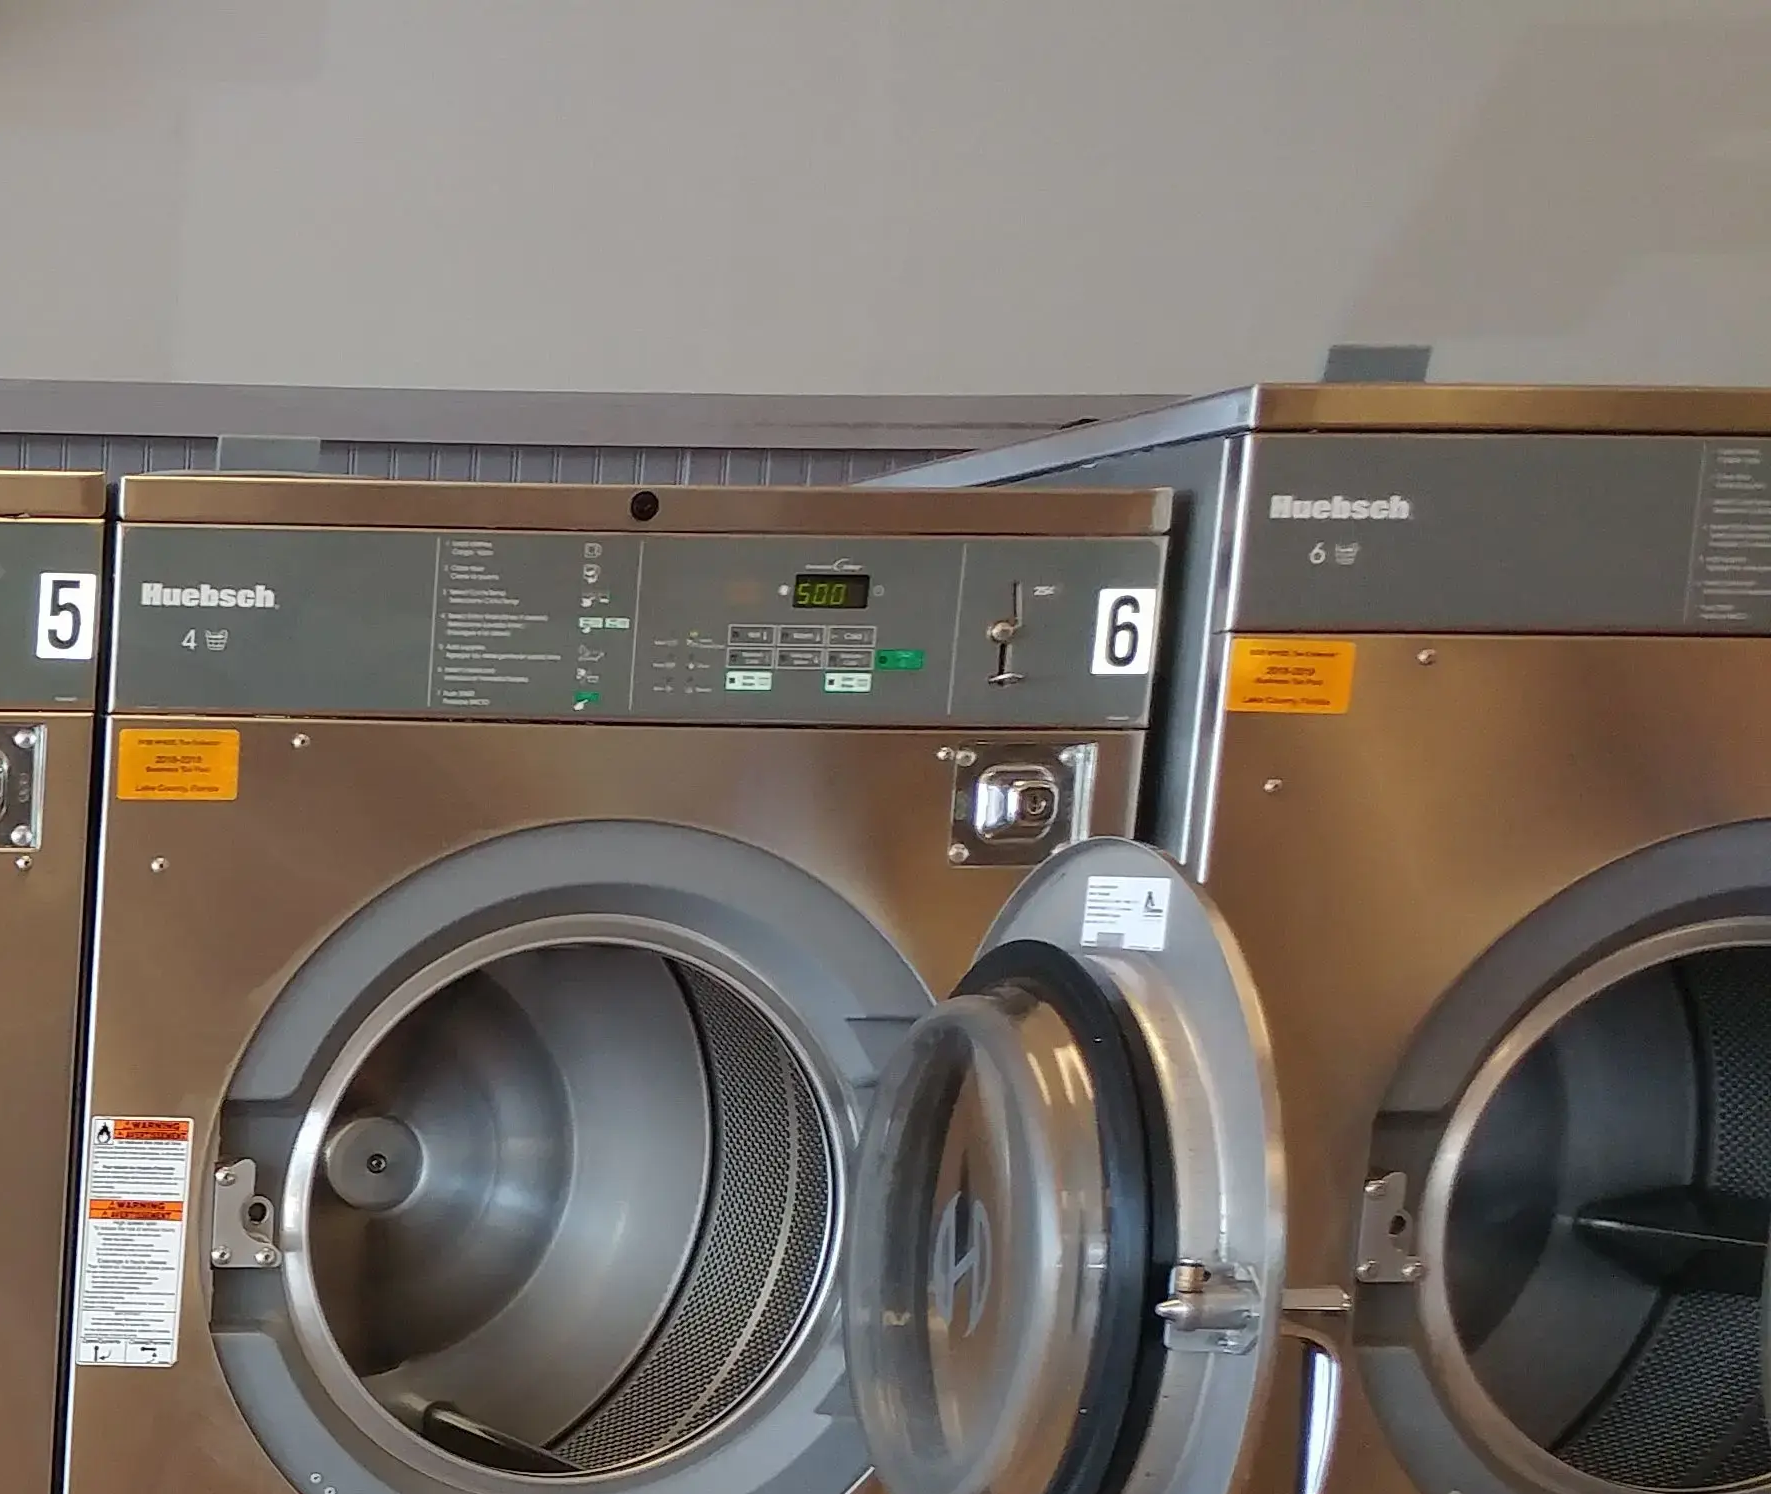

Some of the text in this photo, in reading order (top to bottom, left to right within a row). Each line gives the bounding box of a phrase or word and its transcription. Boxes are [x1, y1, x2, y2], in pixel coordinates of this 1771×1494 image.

[1269, 495, 1410, 520] Huebsch
[1309, 543, 1326, 564] 6
[141, 582, 275, 608] Huebsch
[796, 583, 848, 606] 500
[46, 580, 81, 650] 5
[181, 629, 197, 650] 4
[1107, 595, 1141, 667] 6
[131, 1121, 181, 1130] WARNING
[116, 1201, 166, 1209] WARNING
